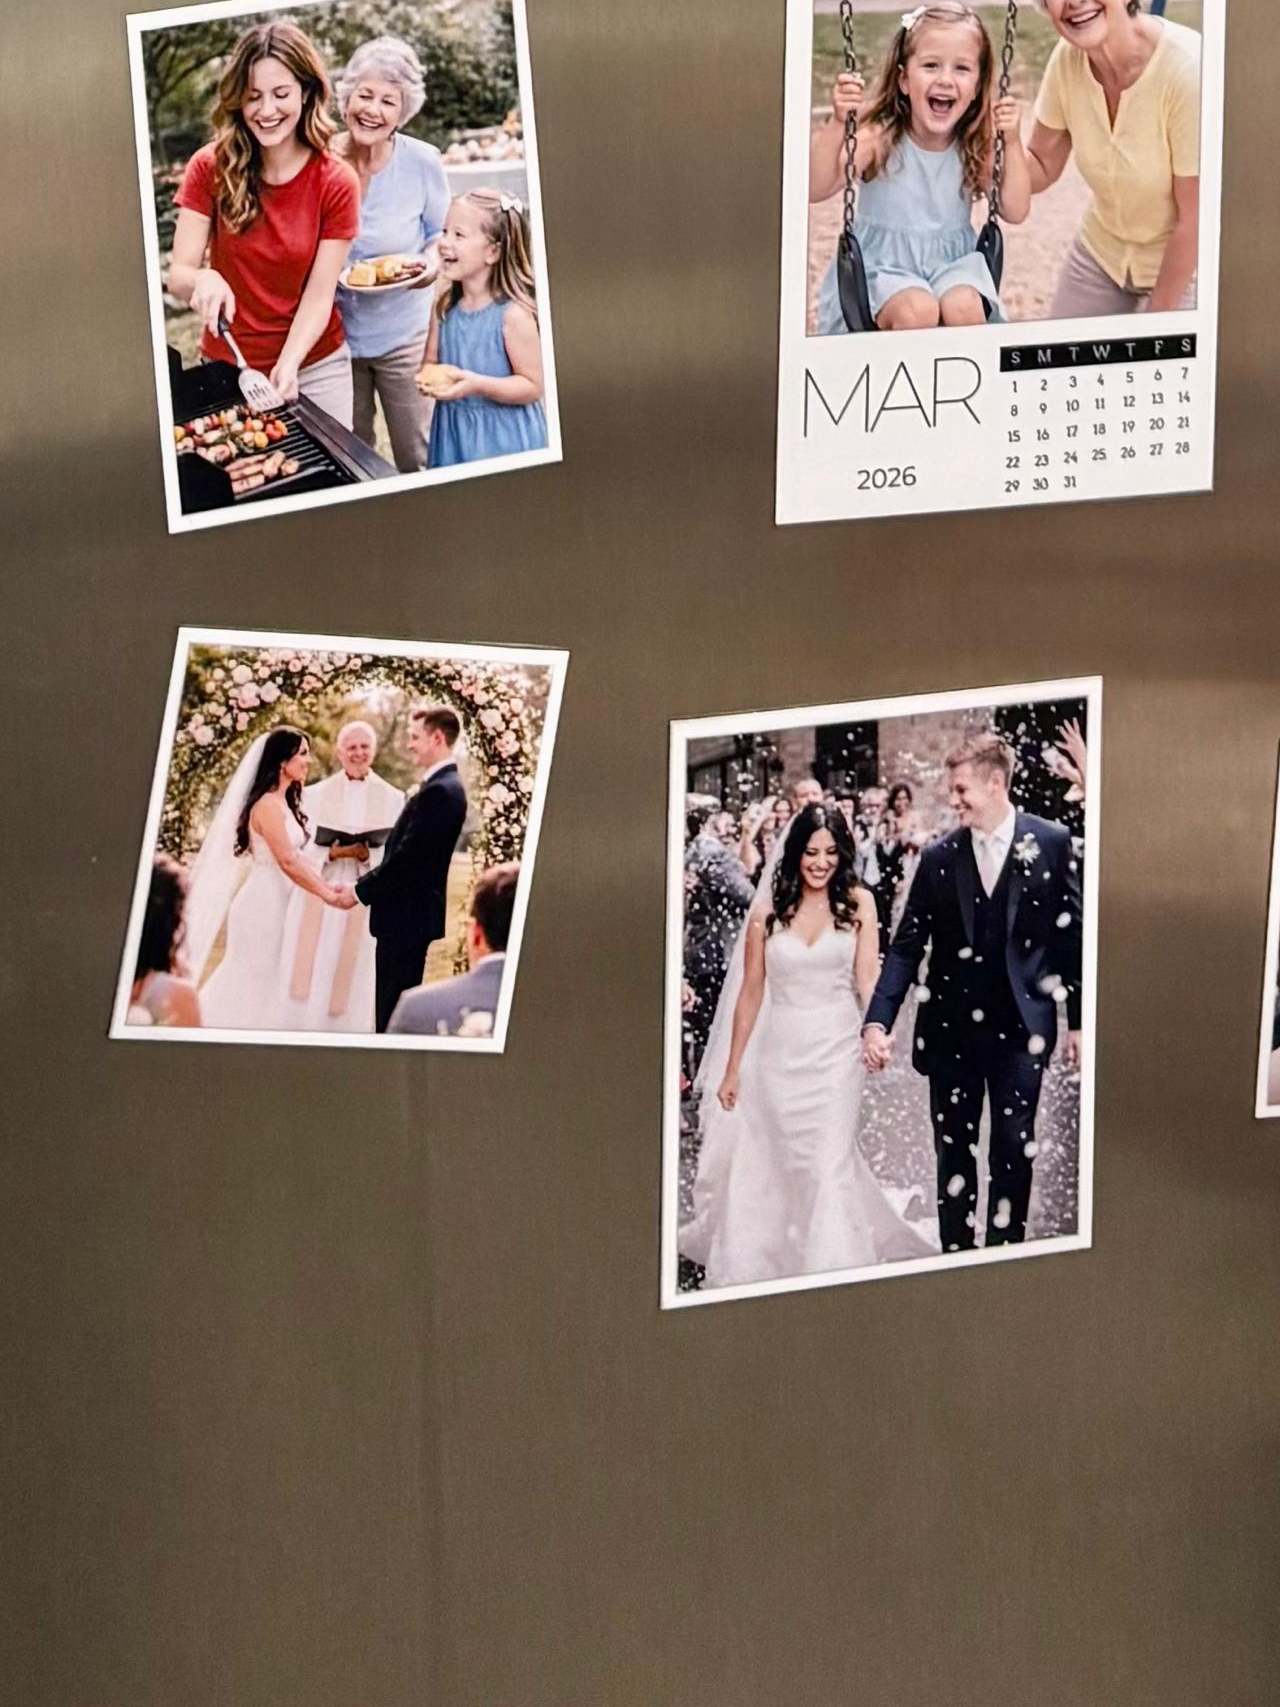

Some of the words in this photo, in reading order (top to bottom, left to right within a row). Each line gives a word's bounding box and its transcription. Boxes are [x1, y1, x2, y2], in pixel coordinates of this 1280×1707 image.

[1011, 350, 1022, 364] S
[1037, 348, 1052, 363] M
[1068, 346, 1081, 361] T
[1092, 344, 1111, 359] W
[1125, 342, 1136, 357] T
[1154, 339, 1164, 355] F
[1181, 338, 1191, 352] S
[1012, 380, 1018, 394] 1
[1040, 378, 1048, 392] 2
[1069, 375, 1078, 389] 3
[1097, 373, 1105, 386] 4
[1126, 371, 1134, 384] 5
[1153, 369, 1163, 381] 6
[1181, 366, 1189, 380] 7
[803, 356, 982, 438] MAR
[1010, 404, 1019, 417] 8
[1039, 402, 1048, 415] 9
[1065, 399, 1080, 413] 10
[1094, 397, 1106, 410] 11
[1123, 395, 1136, 408] 12
[1151, 392, 1164, 405] 13
[1178, 391, 1191, 404] 14
[1007, 429, 1021, 443] 15
[1036, 428, 1050, 442] 16
[1066, 424, 1079, 438] 17
[1092, 422, 1107, 436] 18
[1122, 420, 1136, 434] 19
[1149, 417, 1165, 431] 20
[1177, 416, 1190, 429] 21
[1005, 455, 1020, 469] 22
[1034, 454, 1049, 468] 23
[1063, 451, 1078, 464] 24
[1091, 447, 1107, 461] 25
[1120, 446, 1137, 460] 26
[1149, 442, 1164, 457] 27
[1175, 441, 1190, 455] 28
[857, 465, 917, 491] 2026
[1004, 479, 1021, 493] 29
[1032, 477, 1049, 491] 30
[1063, 475, 1077, 489] 31
